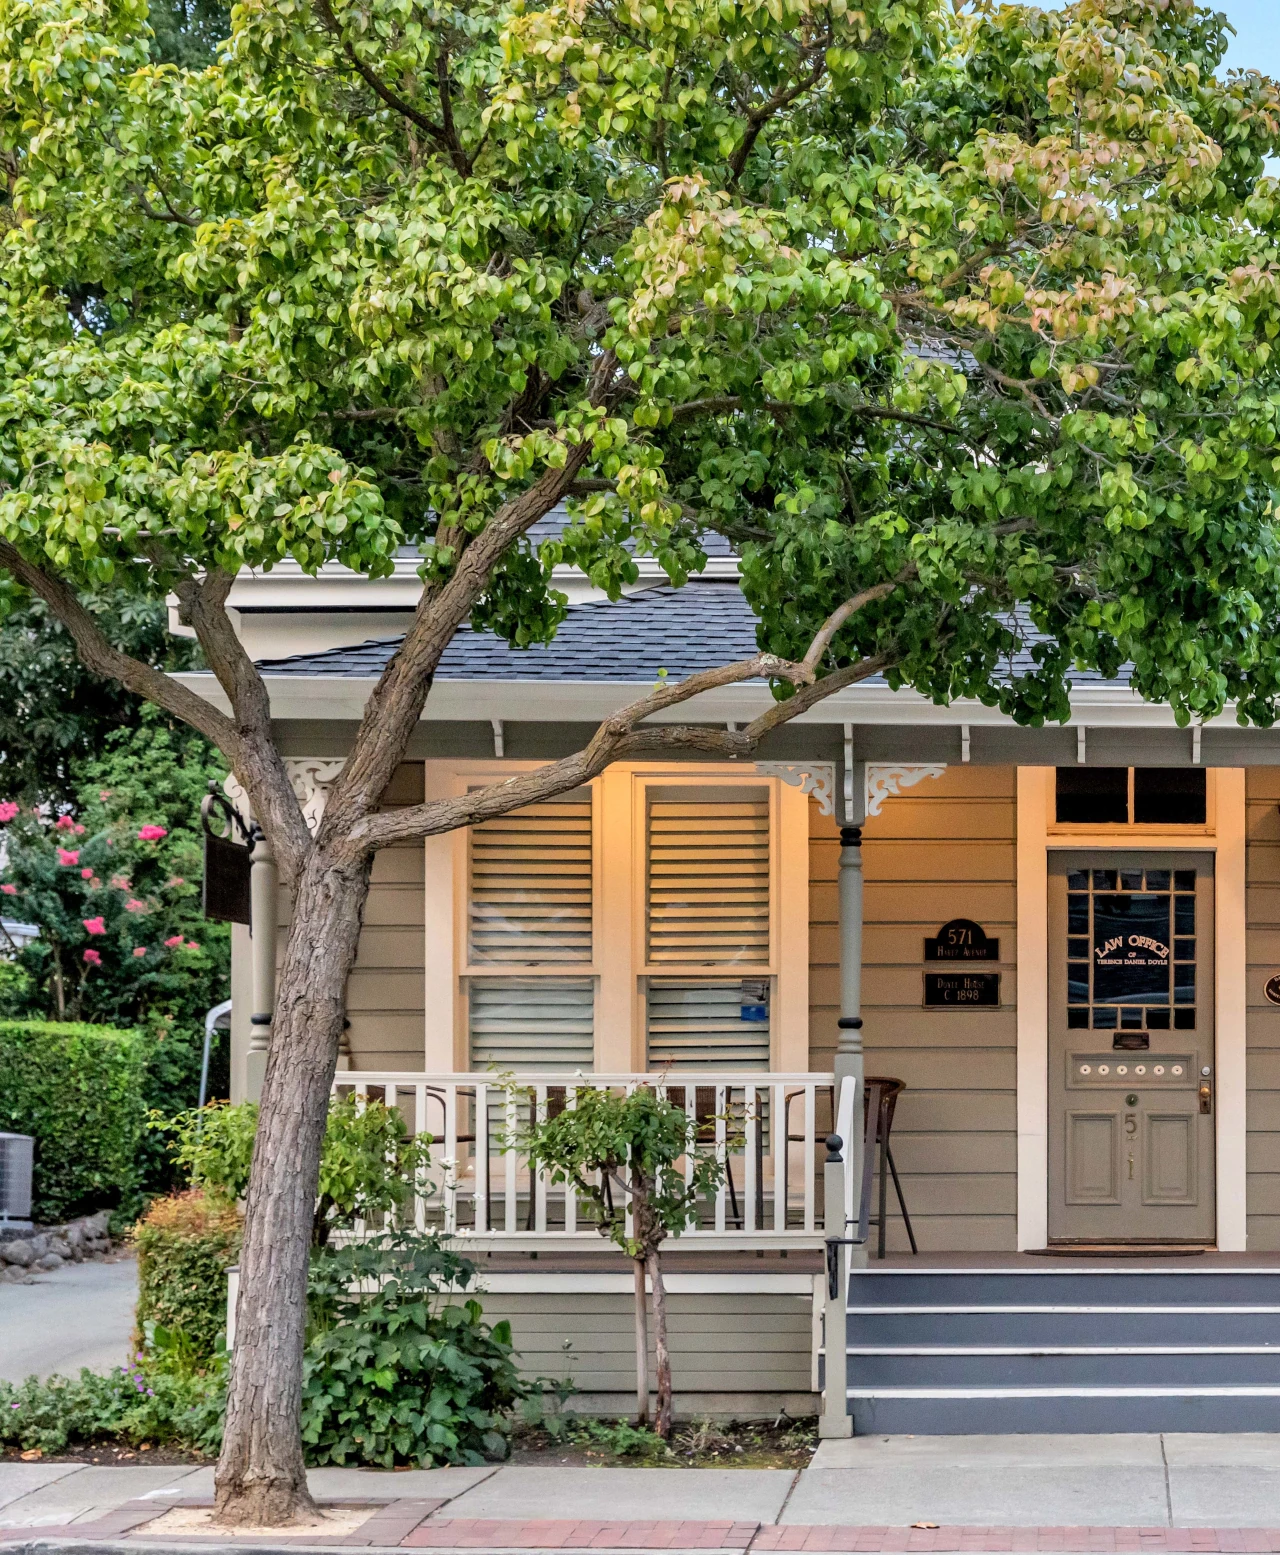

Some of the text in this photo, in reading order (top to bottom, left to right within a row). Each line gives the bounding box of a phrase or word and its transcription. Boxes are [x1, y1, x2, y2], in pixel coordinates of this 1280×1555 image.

[948, 929, 972, 944] 571
[1095, 935, 1170, 958] LAW OFFICE
[944, 990, 979, 1000] C 1898
